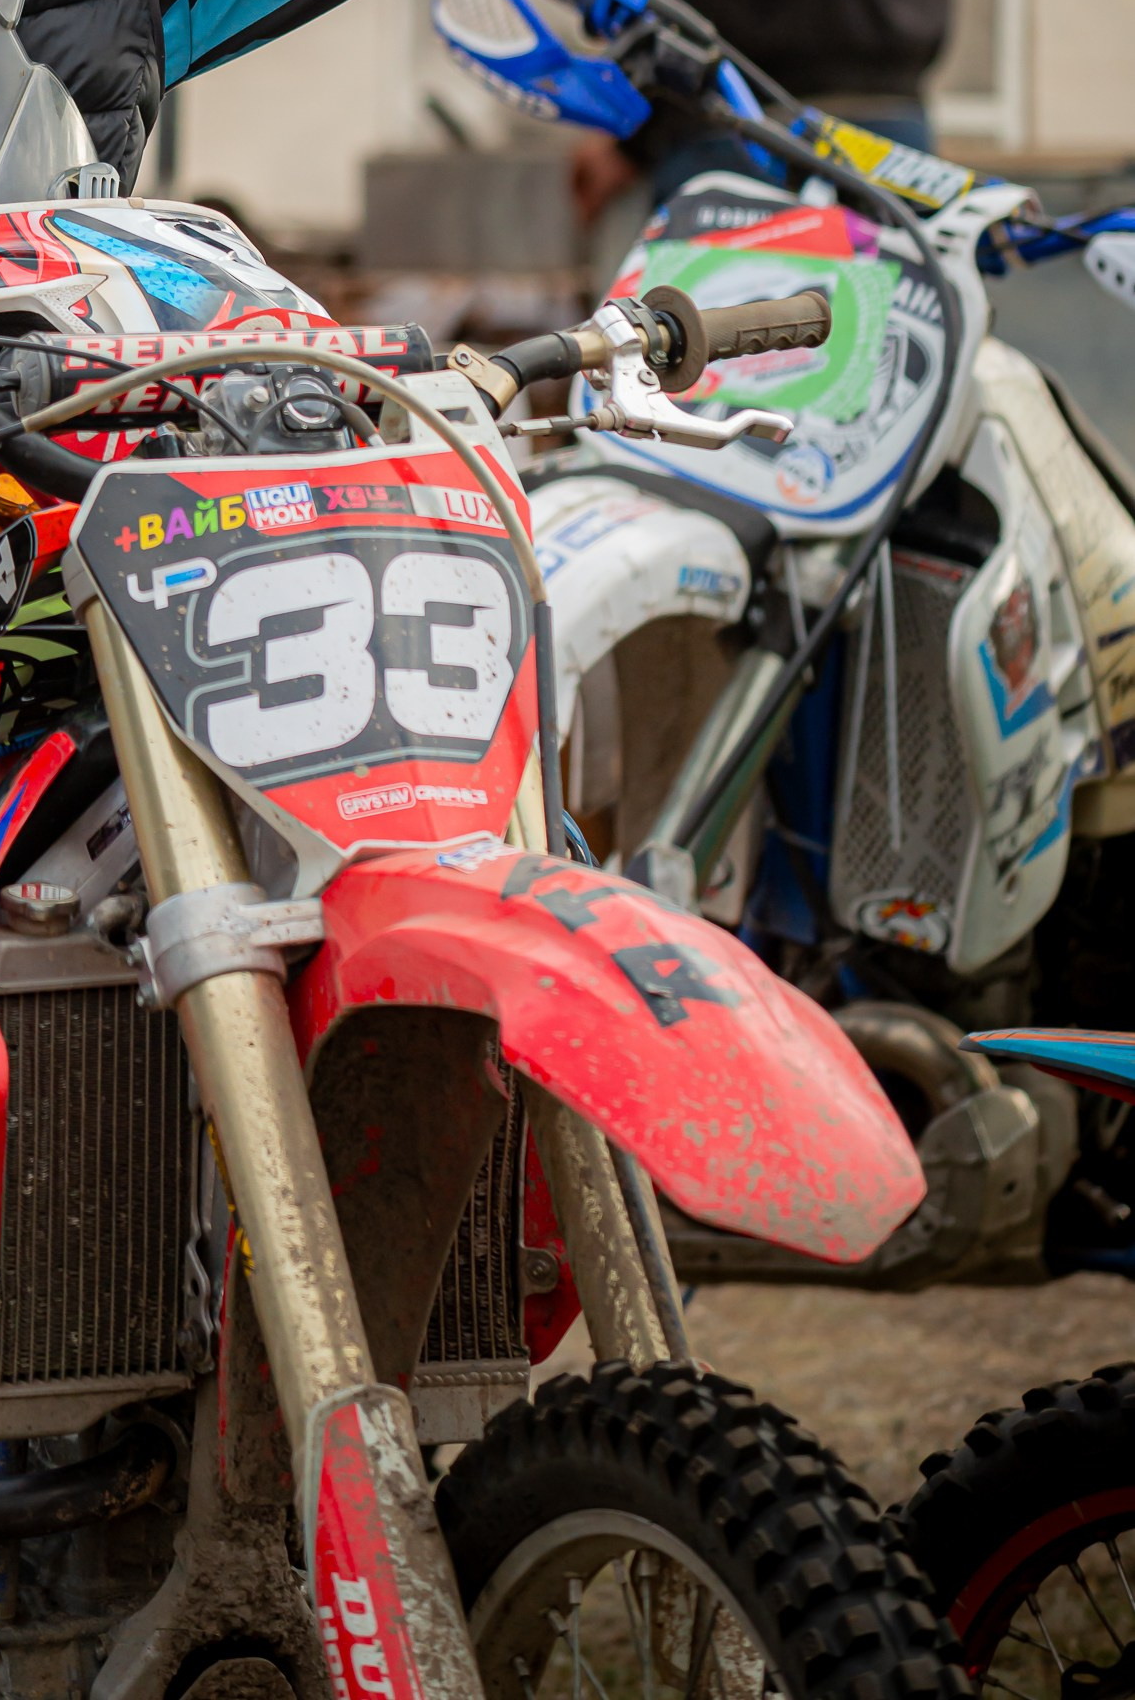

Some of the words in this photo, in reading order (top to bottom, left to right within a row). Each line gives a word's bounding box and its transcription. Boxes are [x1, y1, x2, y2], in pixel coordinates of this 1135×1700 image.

[249, 484, 310, 510] LIQUI
[254, 502, 315, 529] MOLY
[207, 551, 514, 768] 33
